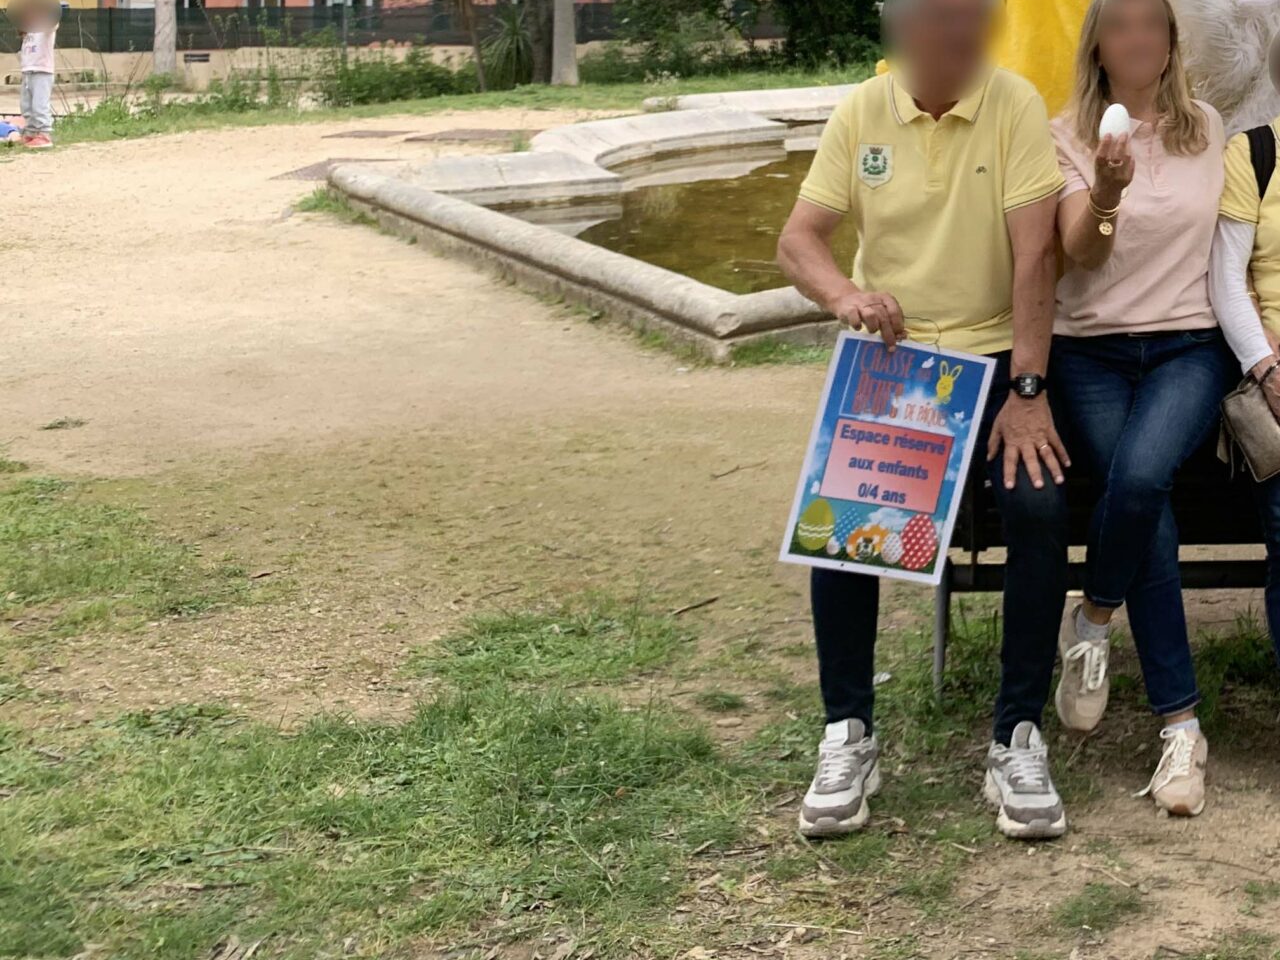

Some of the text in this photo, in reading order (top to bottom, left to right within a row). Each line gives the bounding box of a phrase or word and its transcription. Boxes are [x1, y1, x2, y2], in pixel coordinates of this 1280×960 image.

[840, 423, 946, 455] Espace réservé
[848, 457, 929, 481] aux enfants
[858, 483, 906, 504] 0/4 ans
